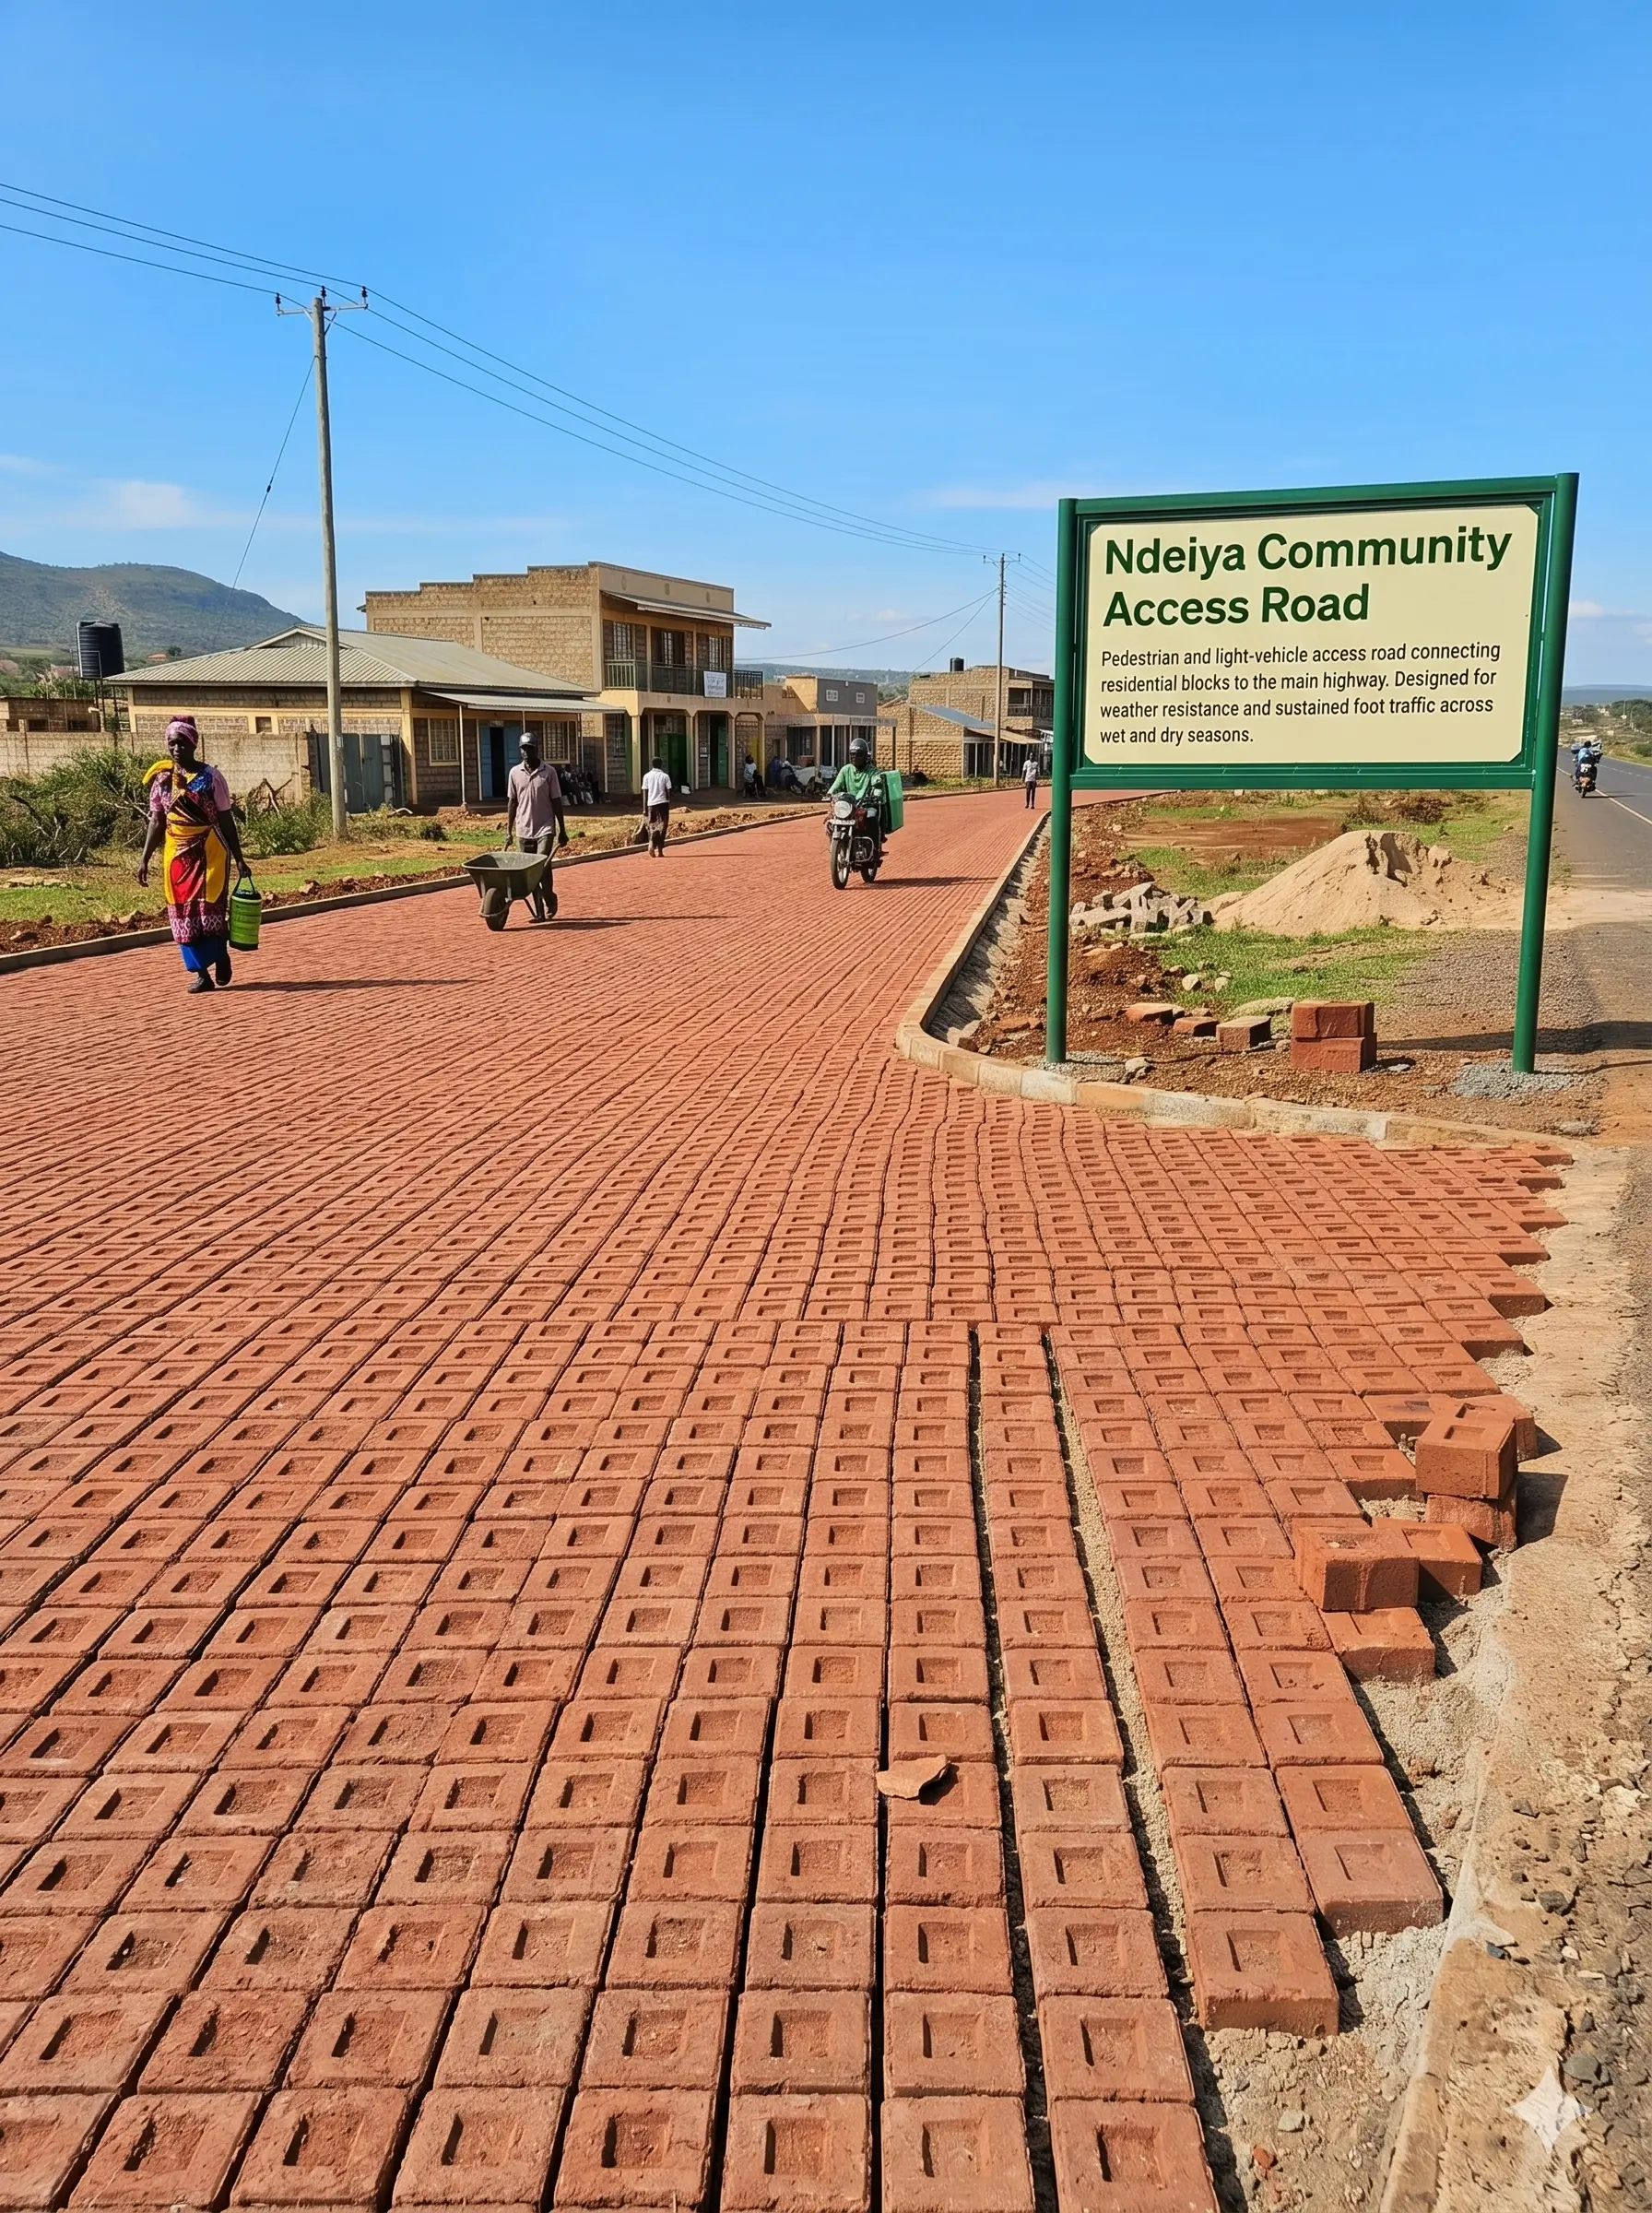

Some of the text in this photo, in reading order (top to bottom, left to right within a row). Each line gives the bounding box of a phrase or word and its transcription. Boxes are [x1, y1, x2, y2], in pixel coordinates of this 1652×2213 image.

[1105, 526, 1513, 580] Ndeiya Community
[1103, 584, 1370, 627] Access Road
[1102, 642, 1501, 668] Pedestrian and light-vehicle access road connecting
[1101, 669, 1497, 692] residential blocks to the main highway. Designed for
[1100, 696, 1494, 718] weather resistance and sustained foot traffic across
[1100, 726, 1255, 747] wet and dry seasons.
